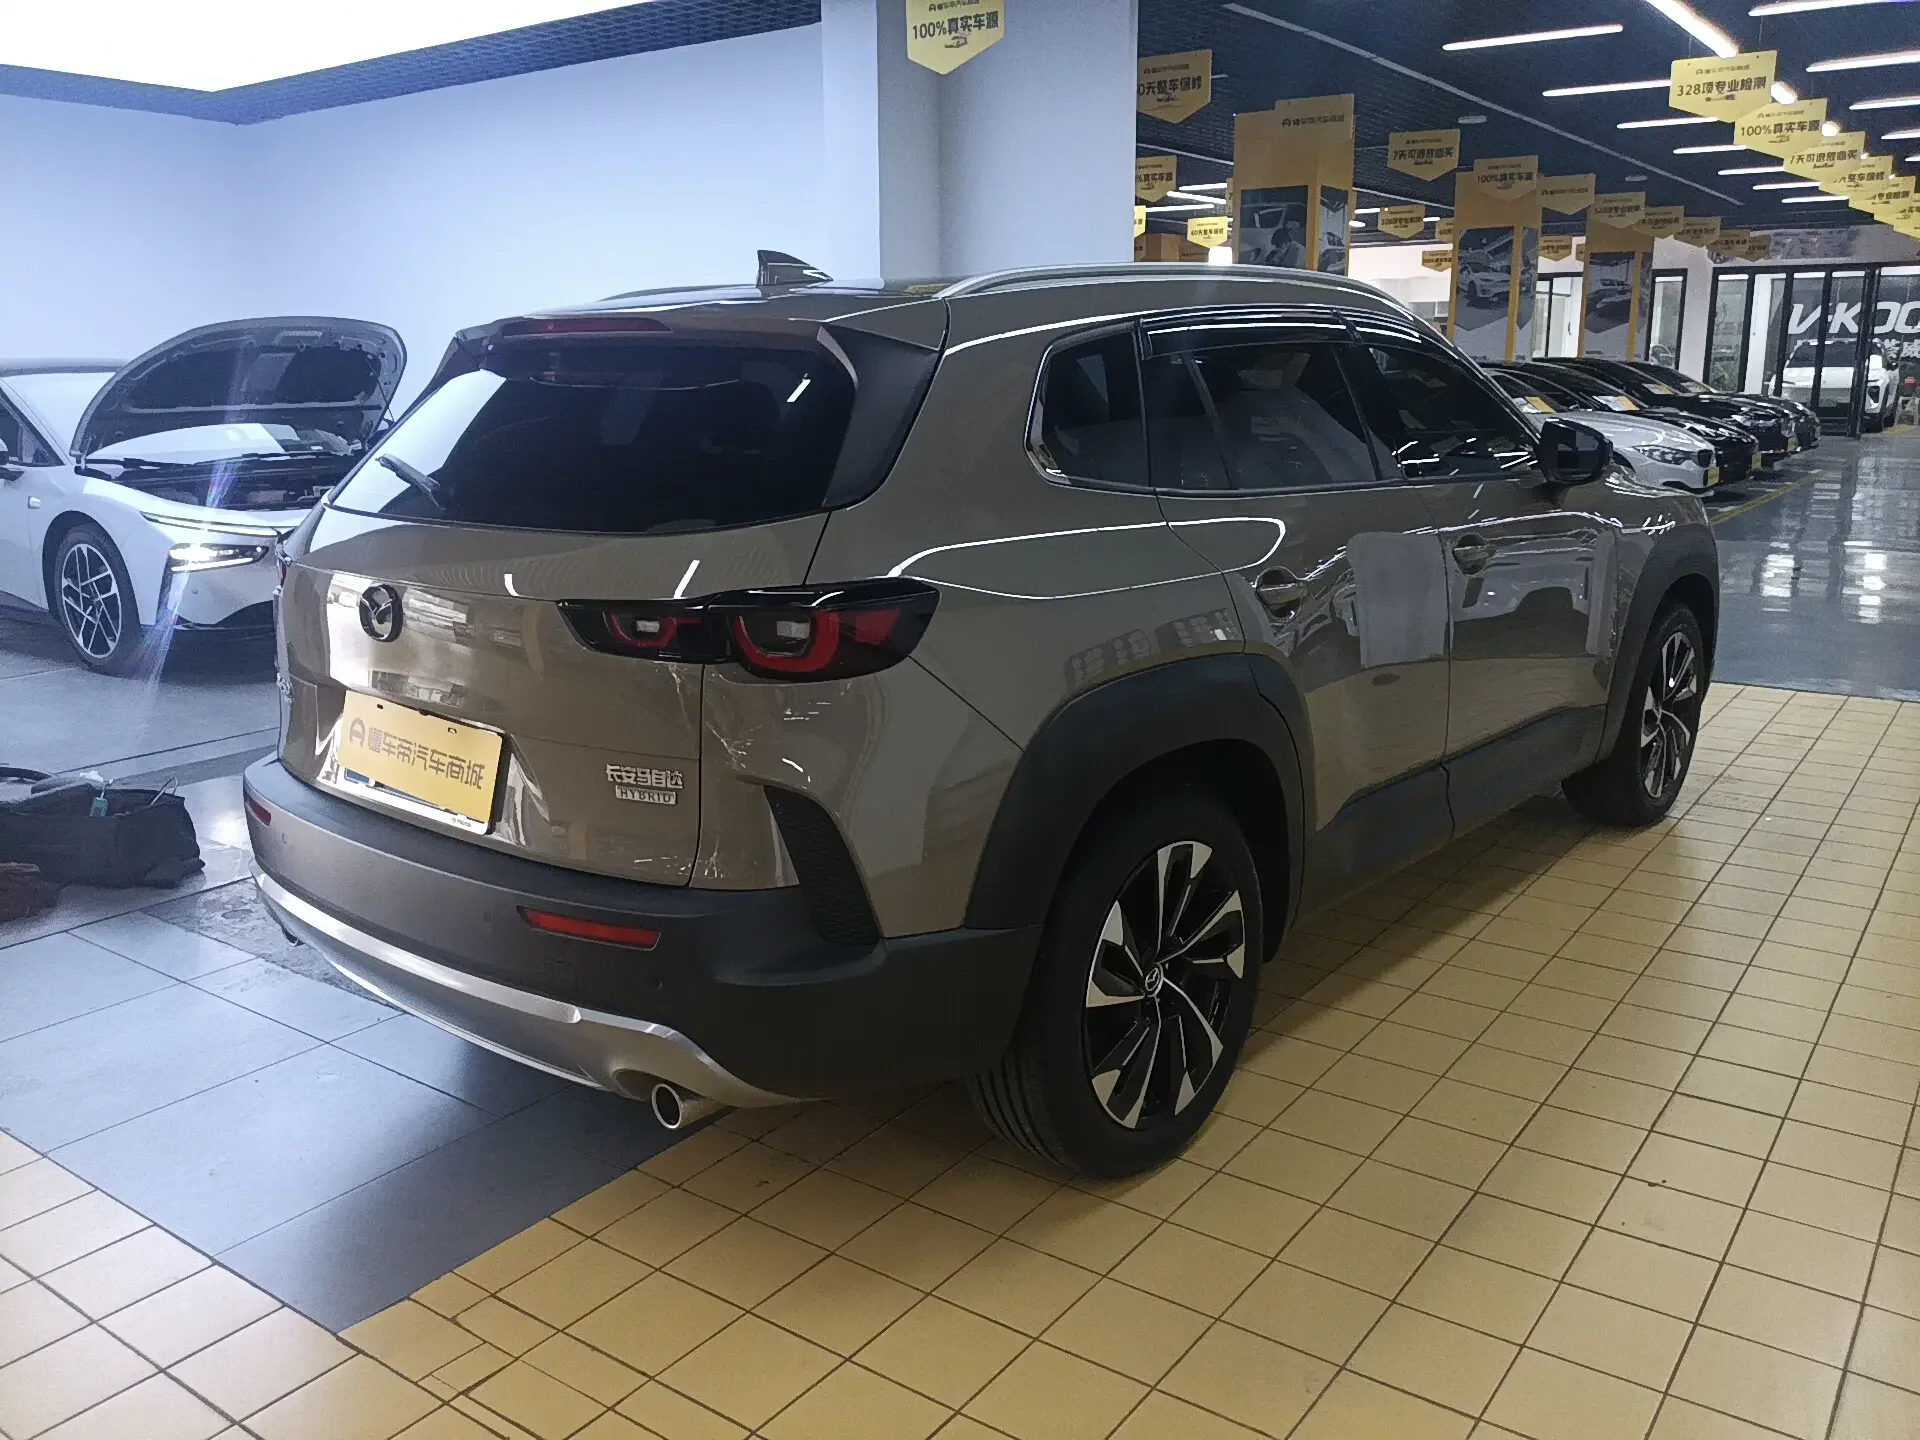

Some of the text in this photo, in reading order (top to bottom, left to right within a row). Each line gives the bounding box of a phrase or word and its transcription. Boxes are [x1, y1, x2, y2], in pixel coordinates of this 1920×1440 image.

[913, 11, 999, 39] 100%真实车源
[1677, 76, 1767, 97] 328项专业检测
[1740, 119, 1821, 137] 100%真实车源
[367, 725, 486, 790] 懂车帝汽车商城
[605, 763, 684, 789] 长安马自达
[619, 787, 672, 803] HYBRID
